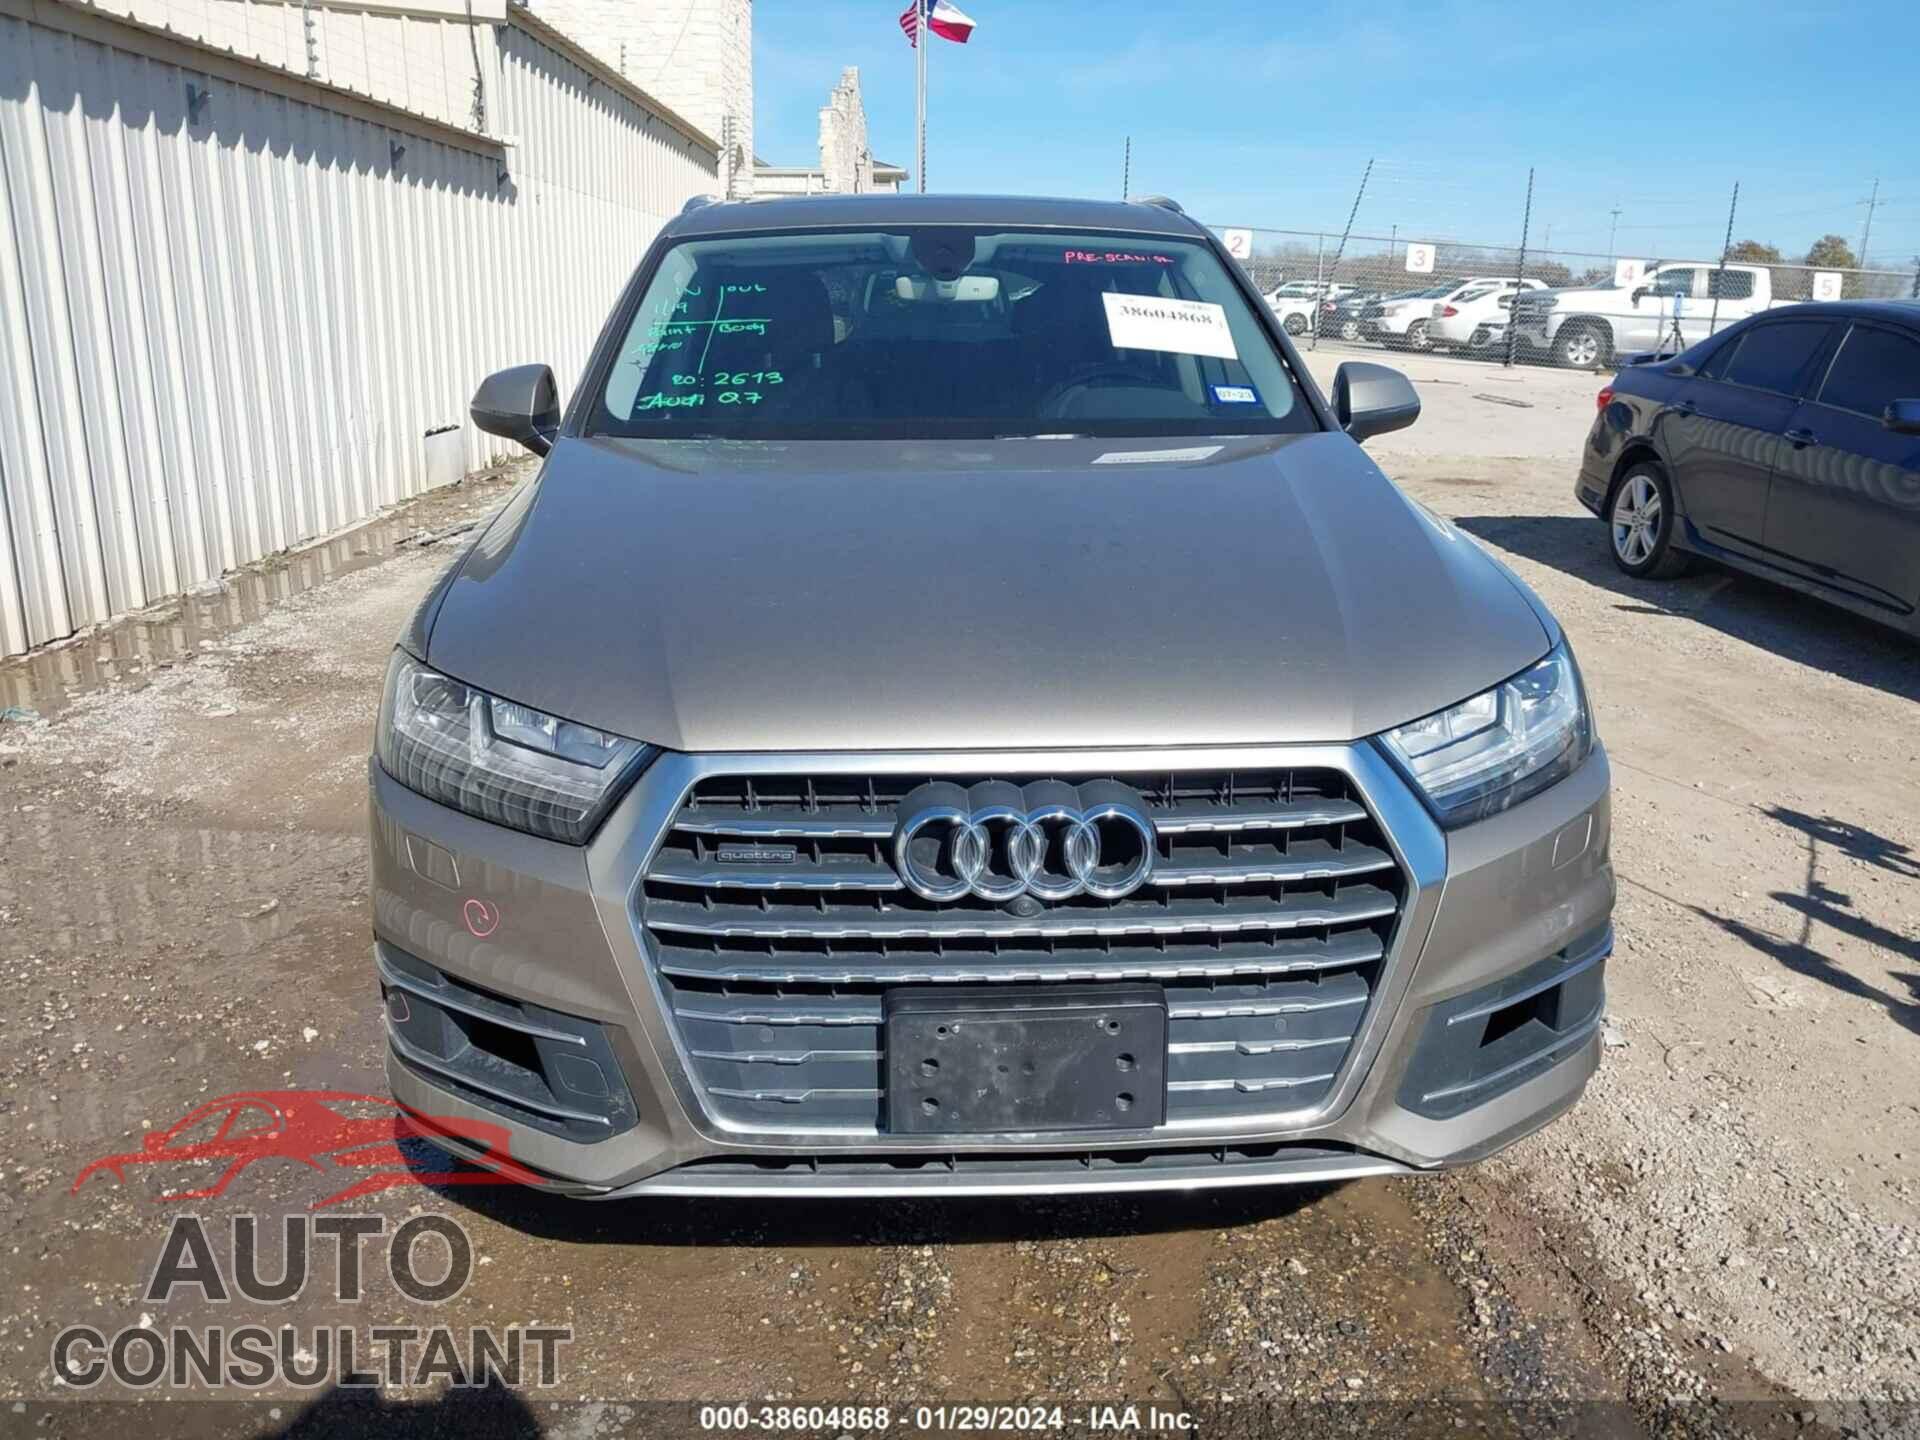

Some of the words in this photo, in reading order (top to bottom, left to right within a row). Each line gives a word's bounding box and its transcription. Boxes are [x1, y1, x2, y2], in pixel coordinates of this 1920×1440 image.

[1231, 235, 1242, 253] 2
[1414, 250, 1425, 267] 3
[1622, 265, 1634, 281] 4
[1822, 279, 1833, 297] 5
[1120, 305, 1213, 325] 38604868
[720, 851, 793, 861] quattro
